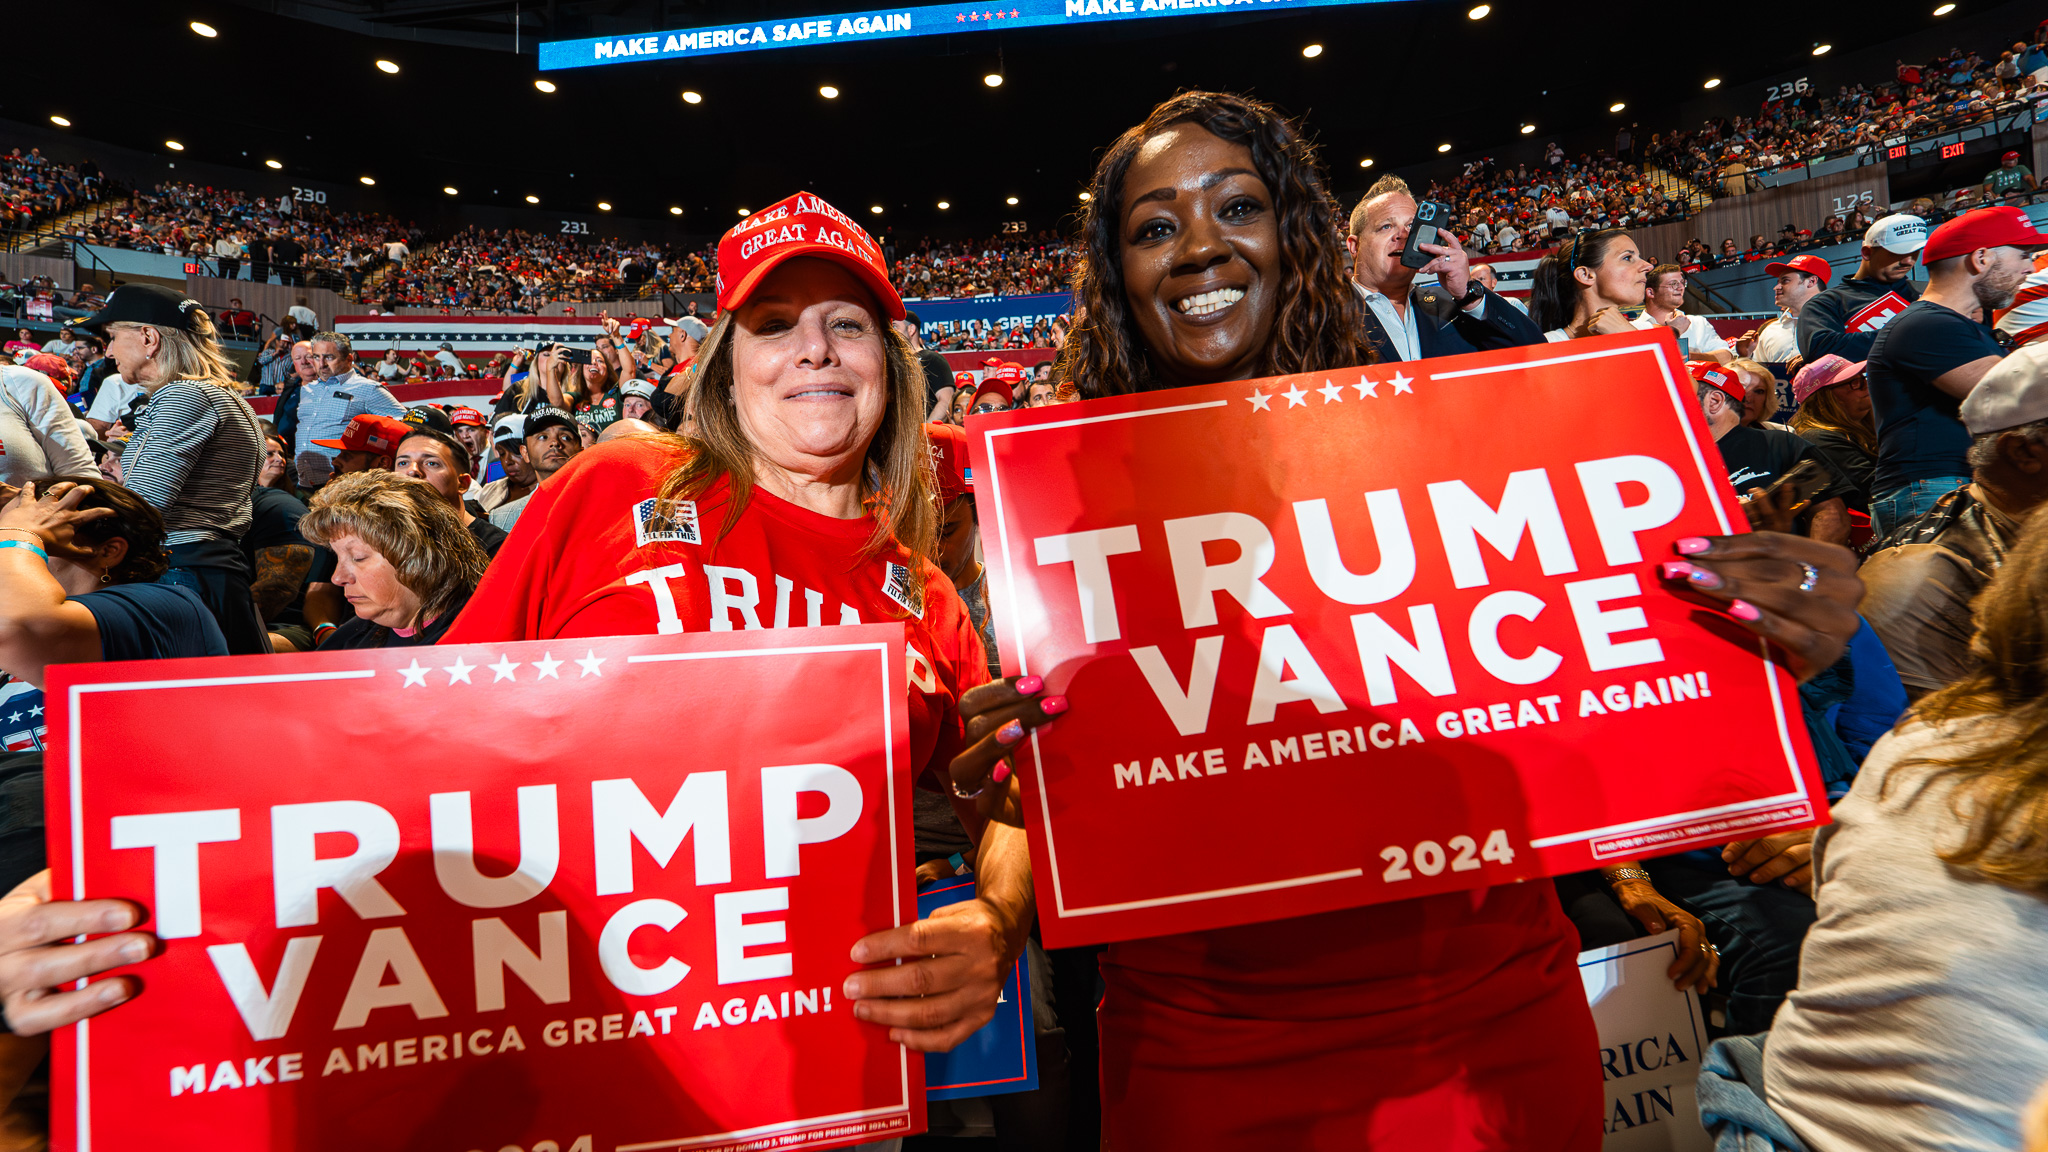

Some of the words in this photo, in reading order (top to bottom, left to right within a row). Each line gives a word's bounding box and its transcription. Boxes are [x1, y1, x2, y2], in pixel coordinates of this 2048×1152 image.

[595, 36, 659, 60] MAKE
[663, 26, 767, 53] AMERICA
[772, 18, 832, 42] SAFE
[837, 13, 912, 35] AGAIN
[1767, 77, 1809, 102] 236
[1889, 145, 1907, 159] EXIT
[1942, 142, 1966, 159] EXIT
[292, 186, 327, 204] 230
[561, 220, 589, 234] 231
[731, 205, 790, 238] MAKE
[793, 195, 876, 253] AMERICA
[1002, 221, 1027, 233] 233
[1893, 223, 1912, 233] MAKE
[1896, 228, 1917, 237] GREAT
[741, 224, 807, 260] GREAT
[815, 226, 874, 265] AGAIN
[998, 314, 1056, 331] GREAT
[531, 409, 546, 420] MAKE
[675, 531, 697, 541] THIS
[1035, 455, 1686, 645] TRUMP
[1129, 573, 1666, 737] VANCE
[1114, 747, 1228, 790] MAKE
[1243, 717, 1425, 770] AMERICA
[1436, 694, 1562, 739] GREAT
[1578, 671, 1711, 718] AGAIN!
[111, 763, 864, 940] TRUMP
[1381, 829, 1515, 883] 2024
[206, 887, 793, 1042] VANCE
[170, 1054, 303, 1097] MAKE
[323, 1026, 525, 1076] AMERICA
[543, 1005, 678, 1047] GREAT
[692, 987, 832, 1031] AGAIN!
[736, 1139, 770, 1152] DONALD
[779, 1133, 807, 1146] TRUMP
[808, 1130, 824, 1140] FOR
[825, 1124, 867, 1138] PRESIDENT
[889, 1118, 905, 1128] INC.
